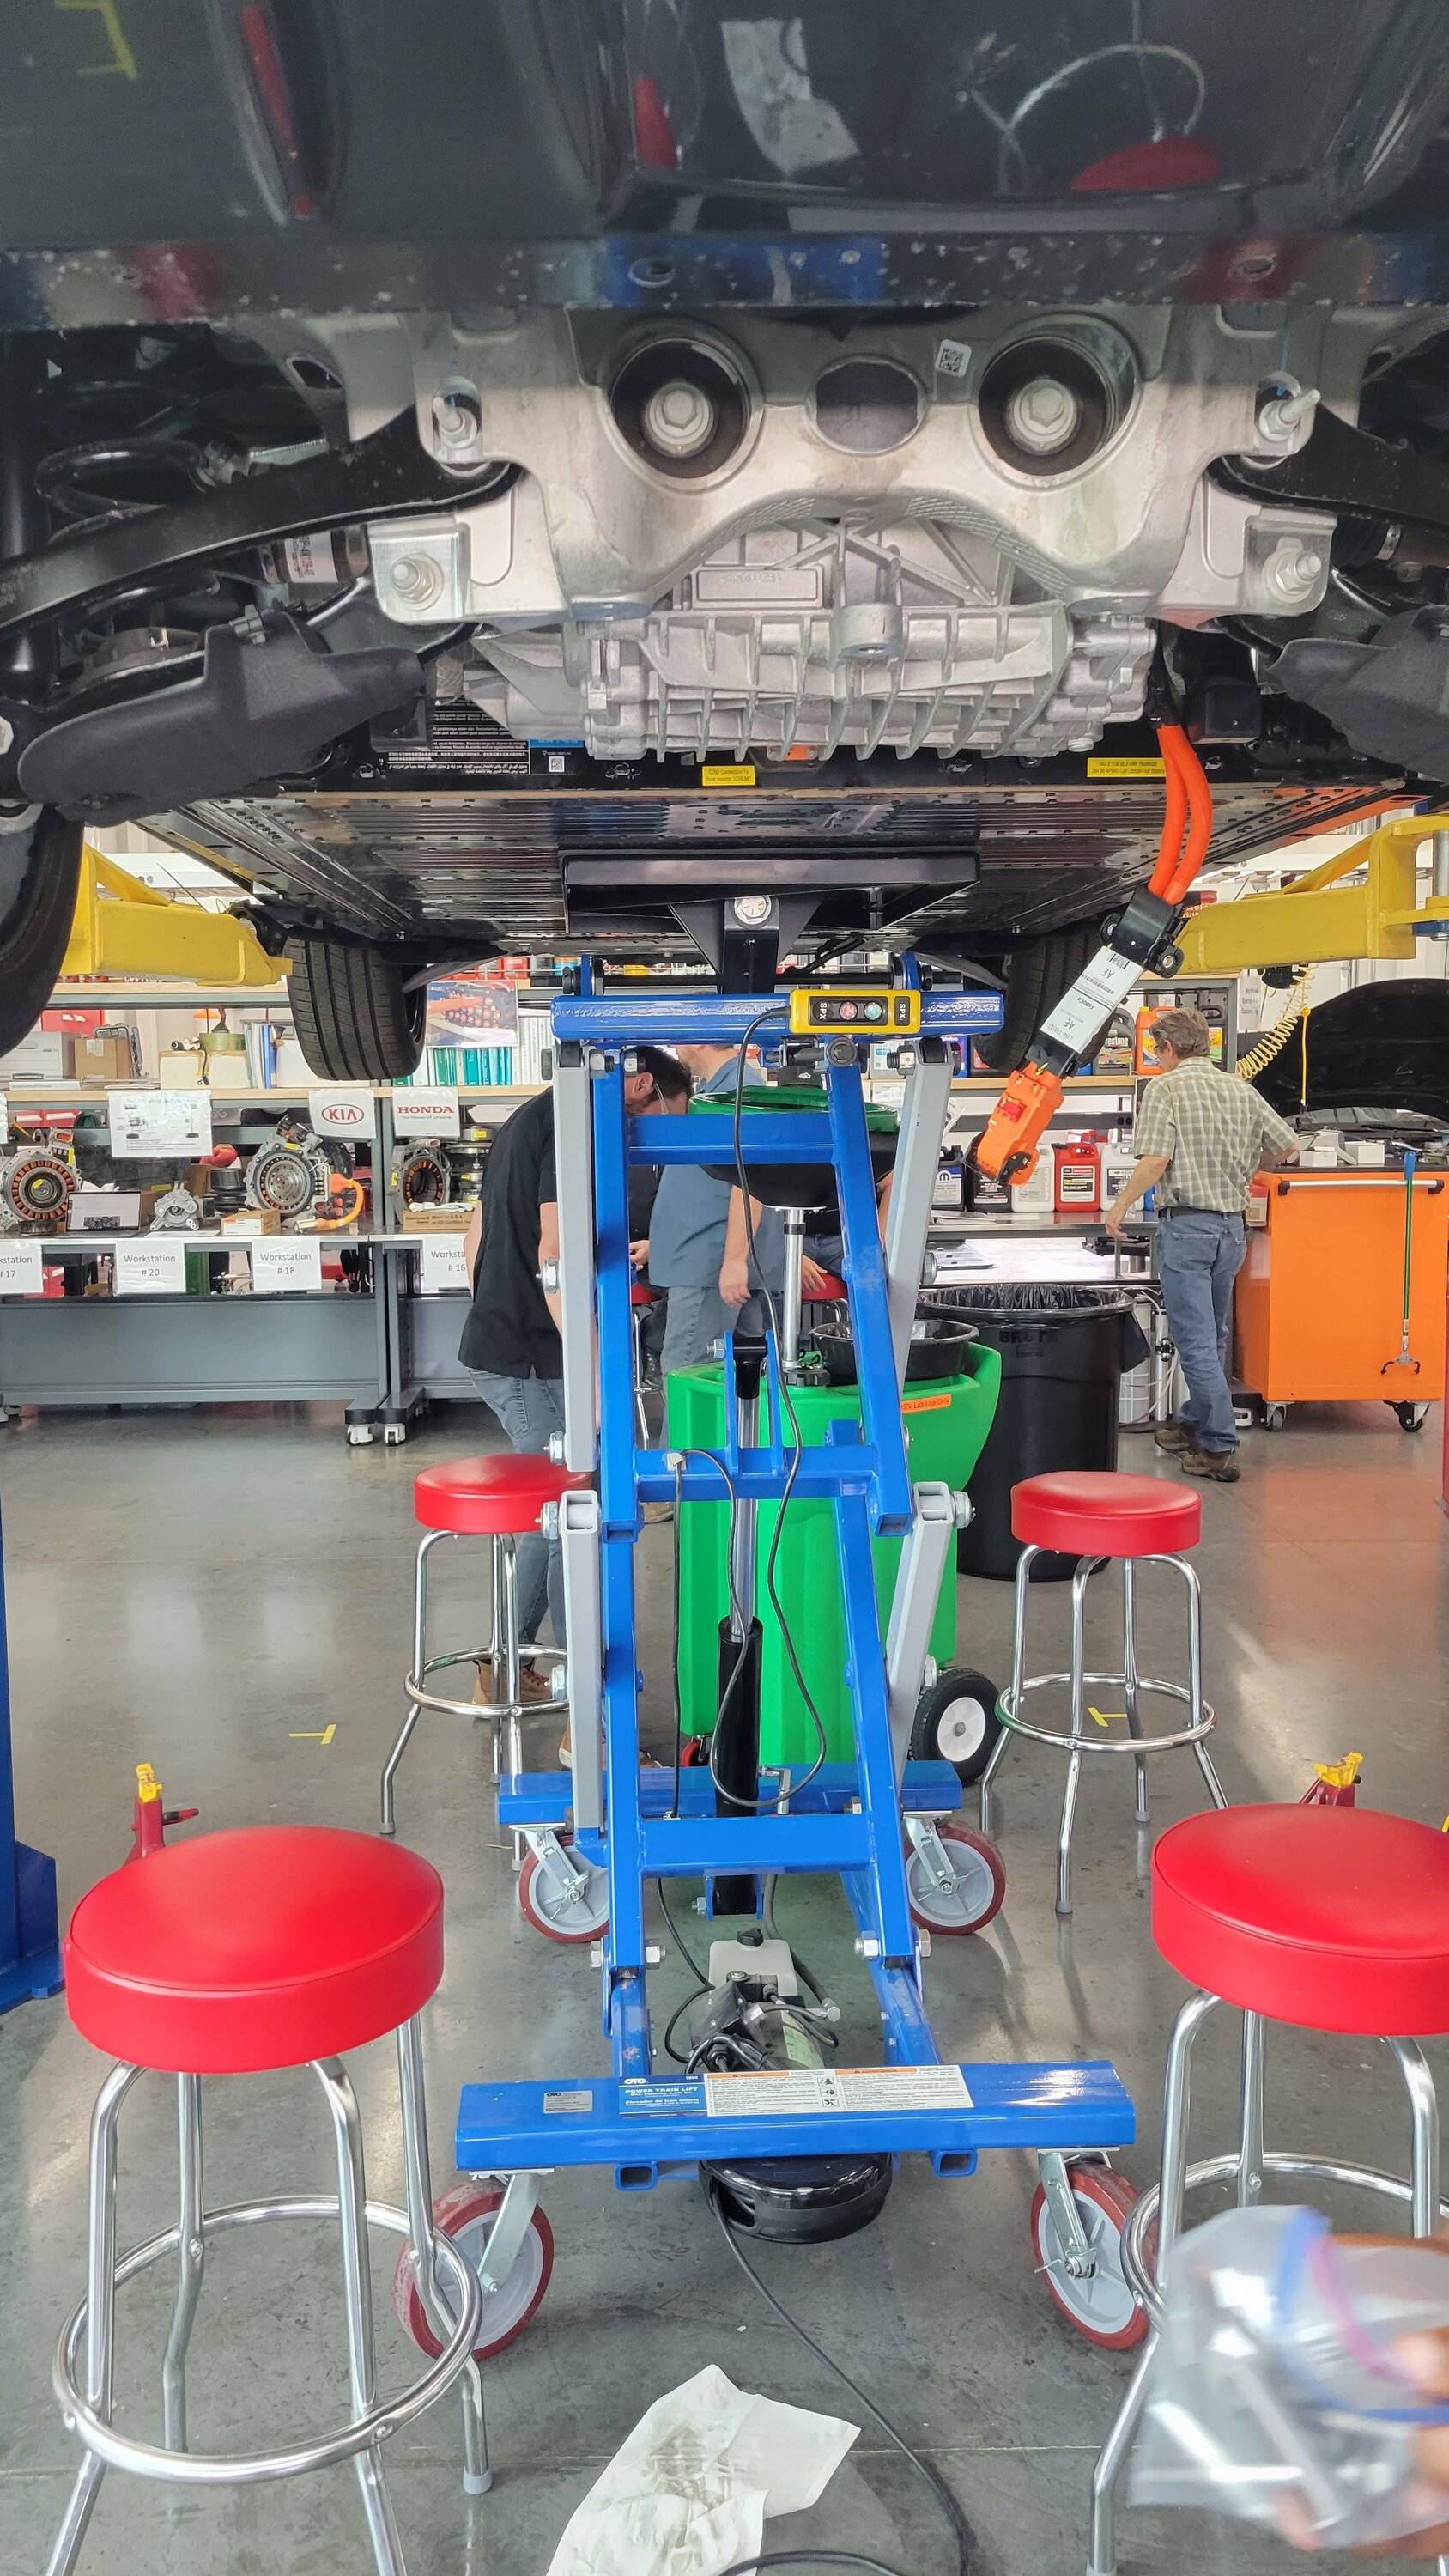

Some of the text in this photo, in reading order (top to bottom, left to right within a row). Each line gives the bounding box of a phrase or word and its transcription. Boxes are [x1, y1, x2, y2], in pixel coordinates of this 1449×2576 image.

[1100, 968, 1114, 979] AE
[819, 1002, 828, 1020] SPX
[1063, 1018, 1077, 1030] AE
[328, 1109, 358, 1121] KIA
[124, 1255, 176, 1263] Workstation
[259, 1252, 312, 1261] Workstation
[149, 1268, 160, 1277] 20
